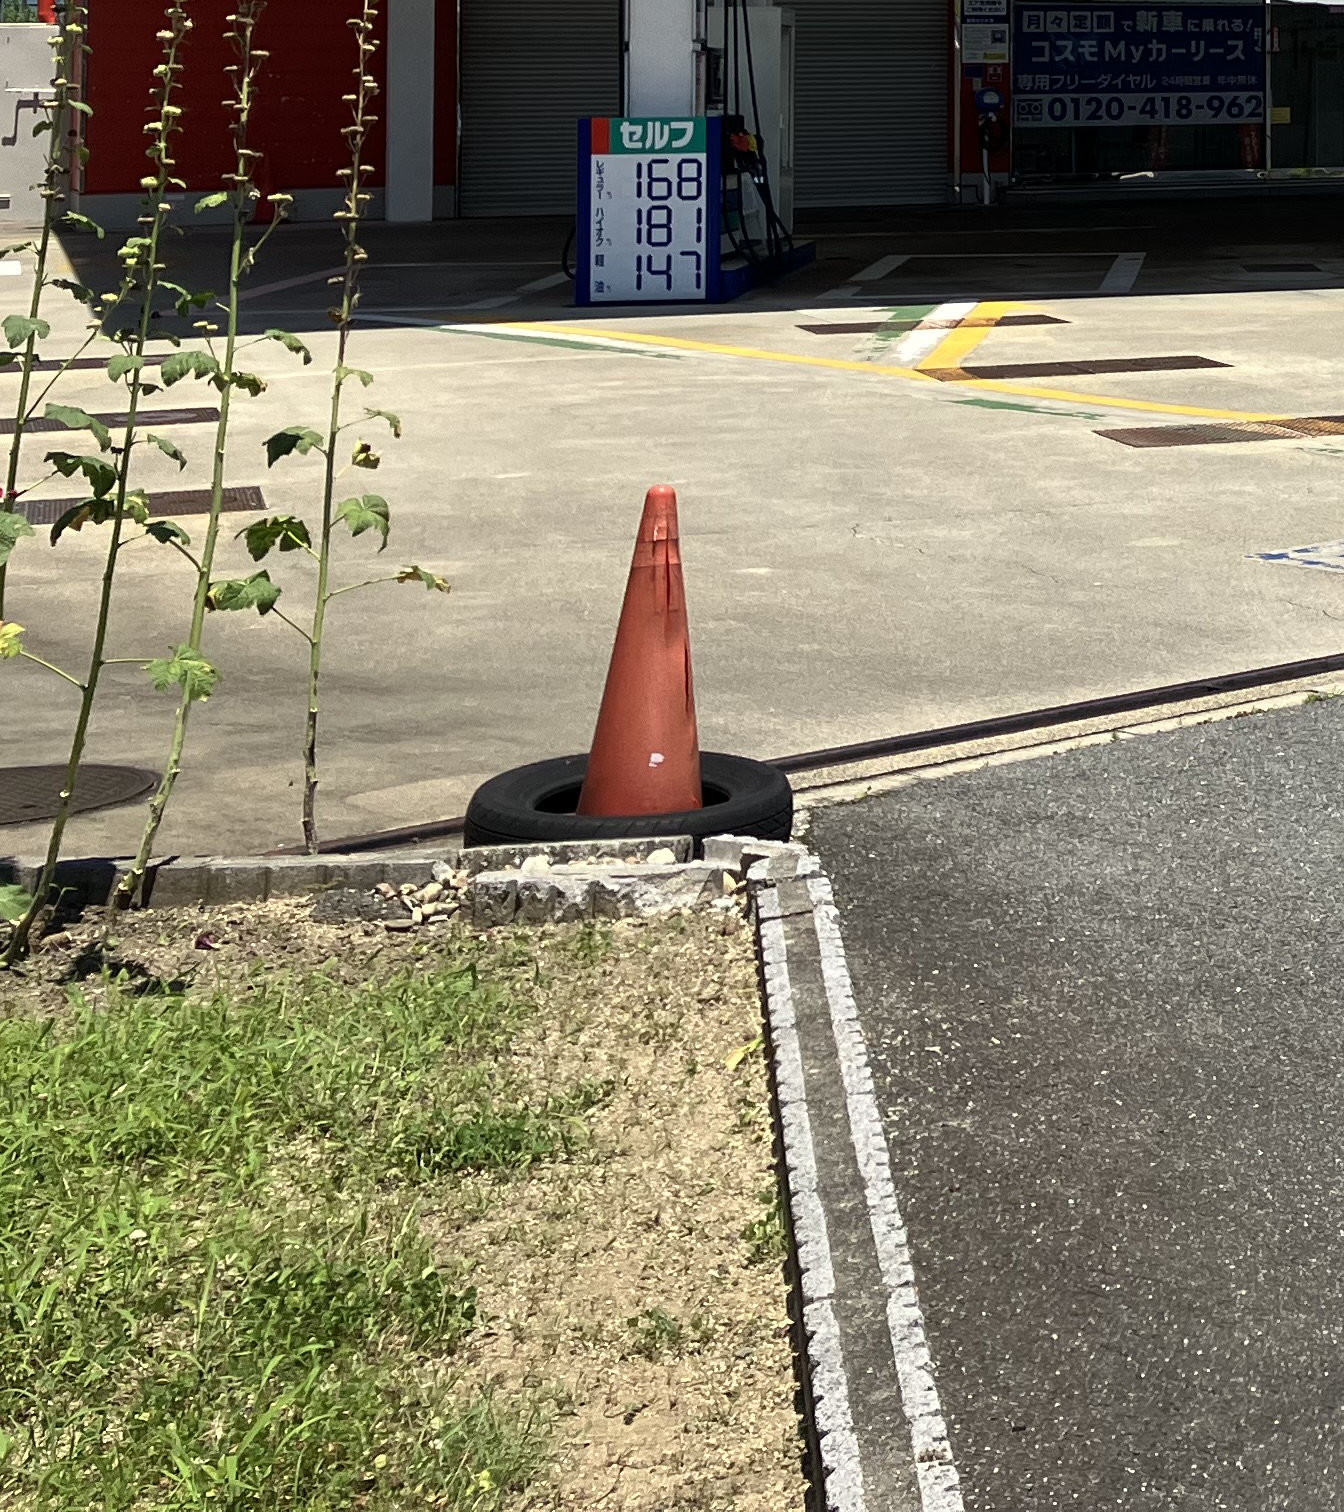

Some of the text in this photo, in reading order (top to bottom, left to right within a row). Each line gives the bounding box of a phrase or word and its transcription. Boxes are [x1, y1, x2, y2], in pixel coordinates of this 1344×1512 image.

[1016, 73, 1156, 90] 専用フリーダイヤル
[1047, 95, 1263, 121] 0120-418-962
[620, 121, 694, 150] セルフ
[595, 160, 605, 200] レギュラー
[635, 158, 702, 201] 168
[595, 207, 605, 247] ハイオク
[635, 205, 702, 247] 181
[635, 251, 702, 291] 147
